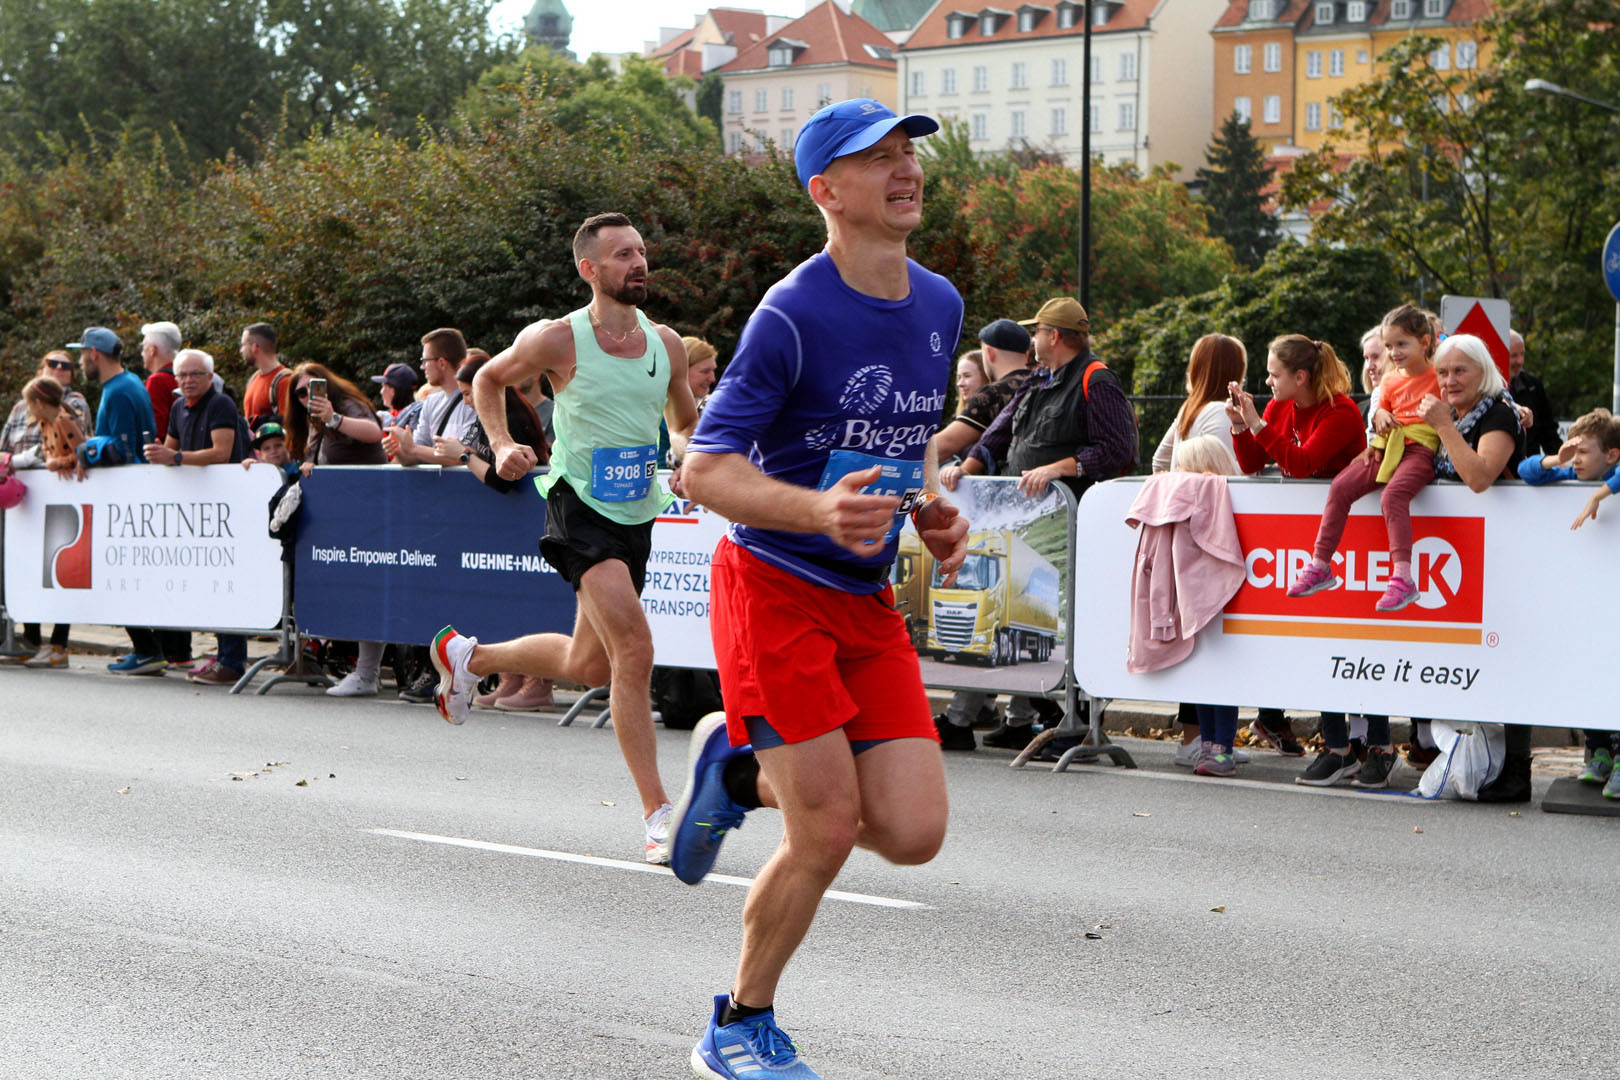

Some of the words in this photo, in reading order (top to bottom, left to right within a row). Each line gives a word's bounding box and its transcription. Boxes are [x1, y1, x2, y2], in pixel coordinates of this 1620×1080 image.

[604, 463, 641, 480] 3908
[106, 502, 235, 538] PARTNER
[105, 546, 127, 566] OF
[132, 546, 235, 567] PROMOTION
[312, 545, 348, 564] Inspire.
[350, 547, 399, 566] Empower.
[400, 549, 437, 567] Deliver.
[1245, 547, 1392, 592] CIRCLE
[105, 578, 142, 592] ART
[165, 579, 187, 592] OF
[213, 579, 234, 593] PR
[1331, 656, 1386, 682] Take
[1393, 659, 1412, 682] it
[1420, 665, 1480, 691] easy
